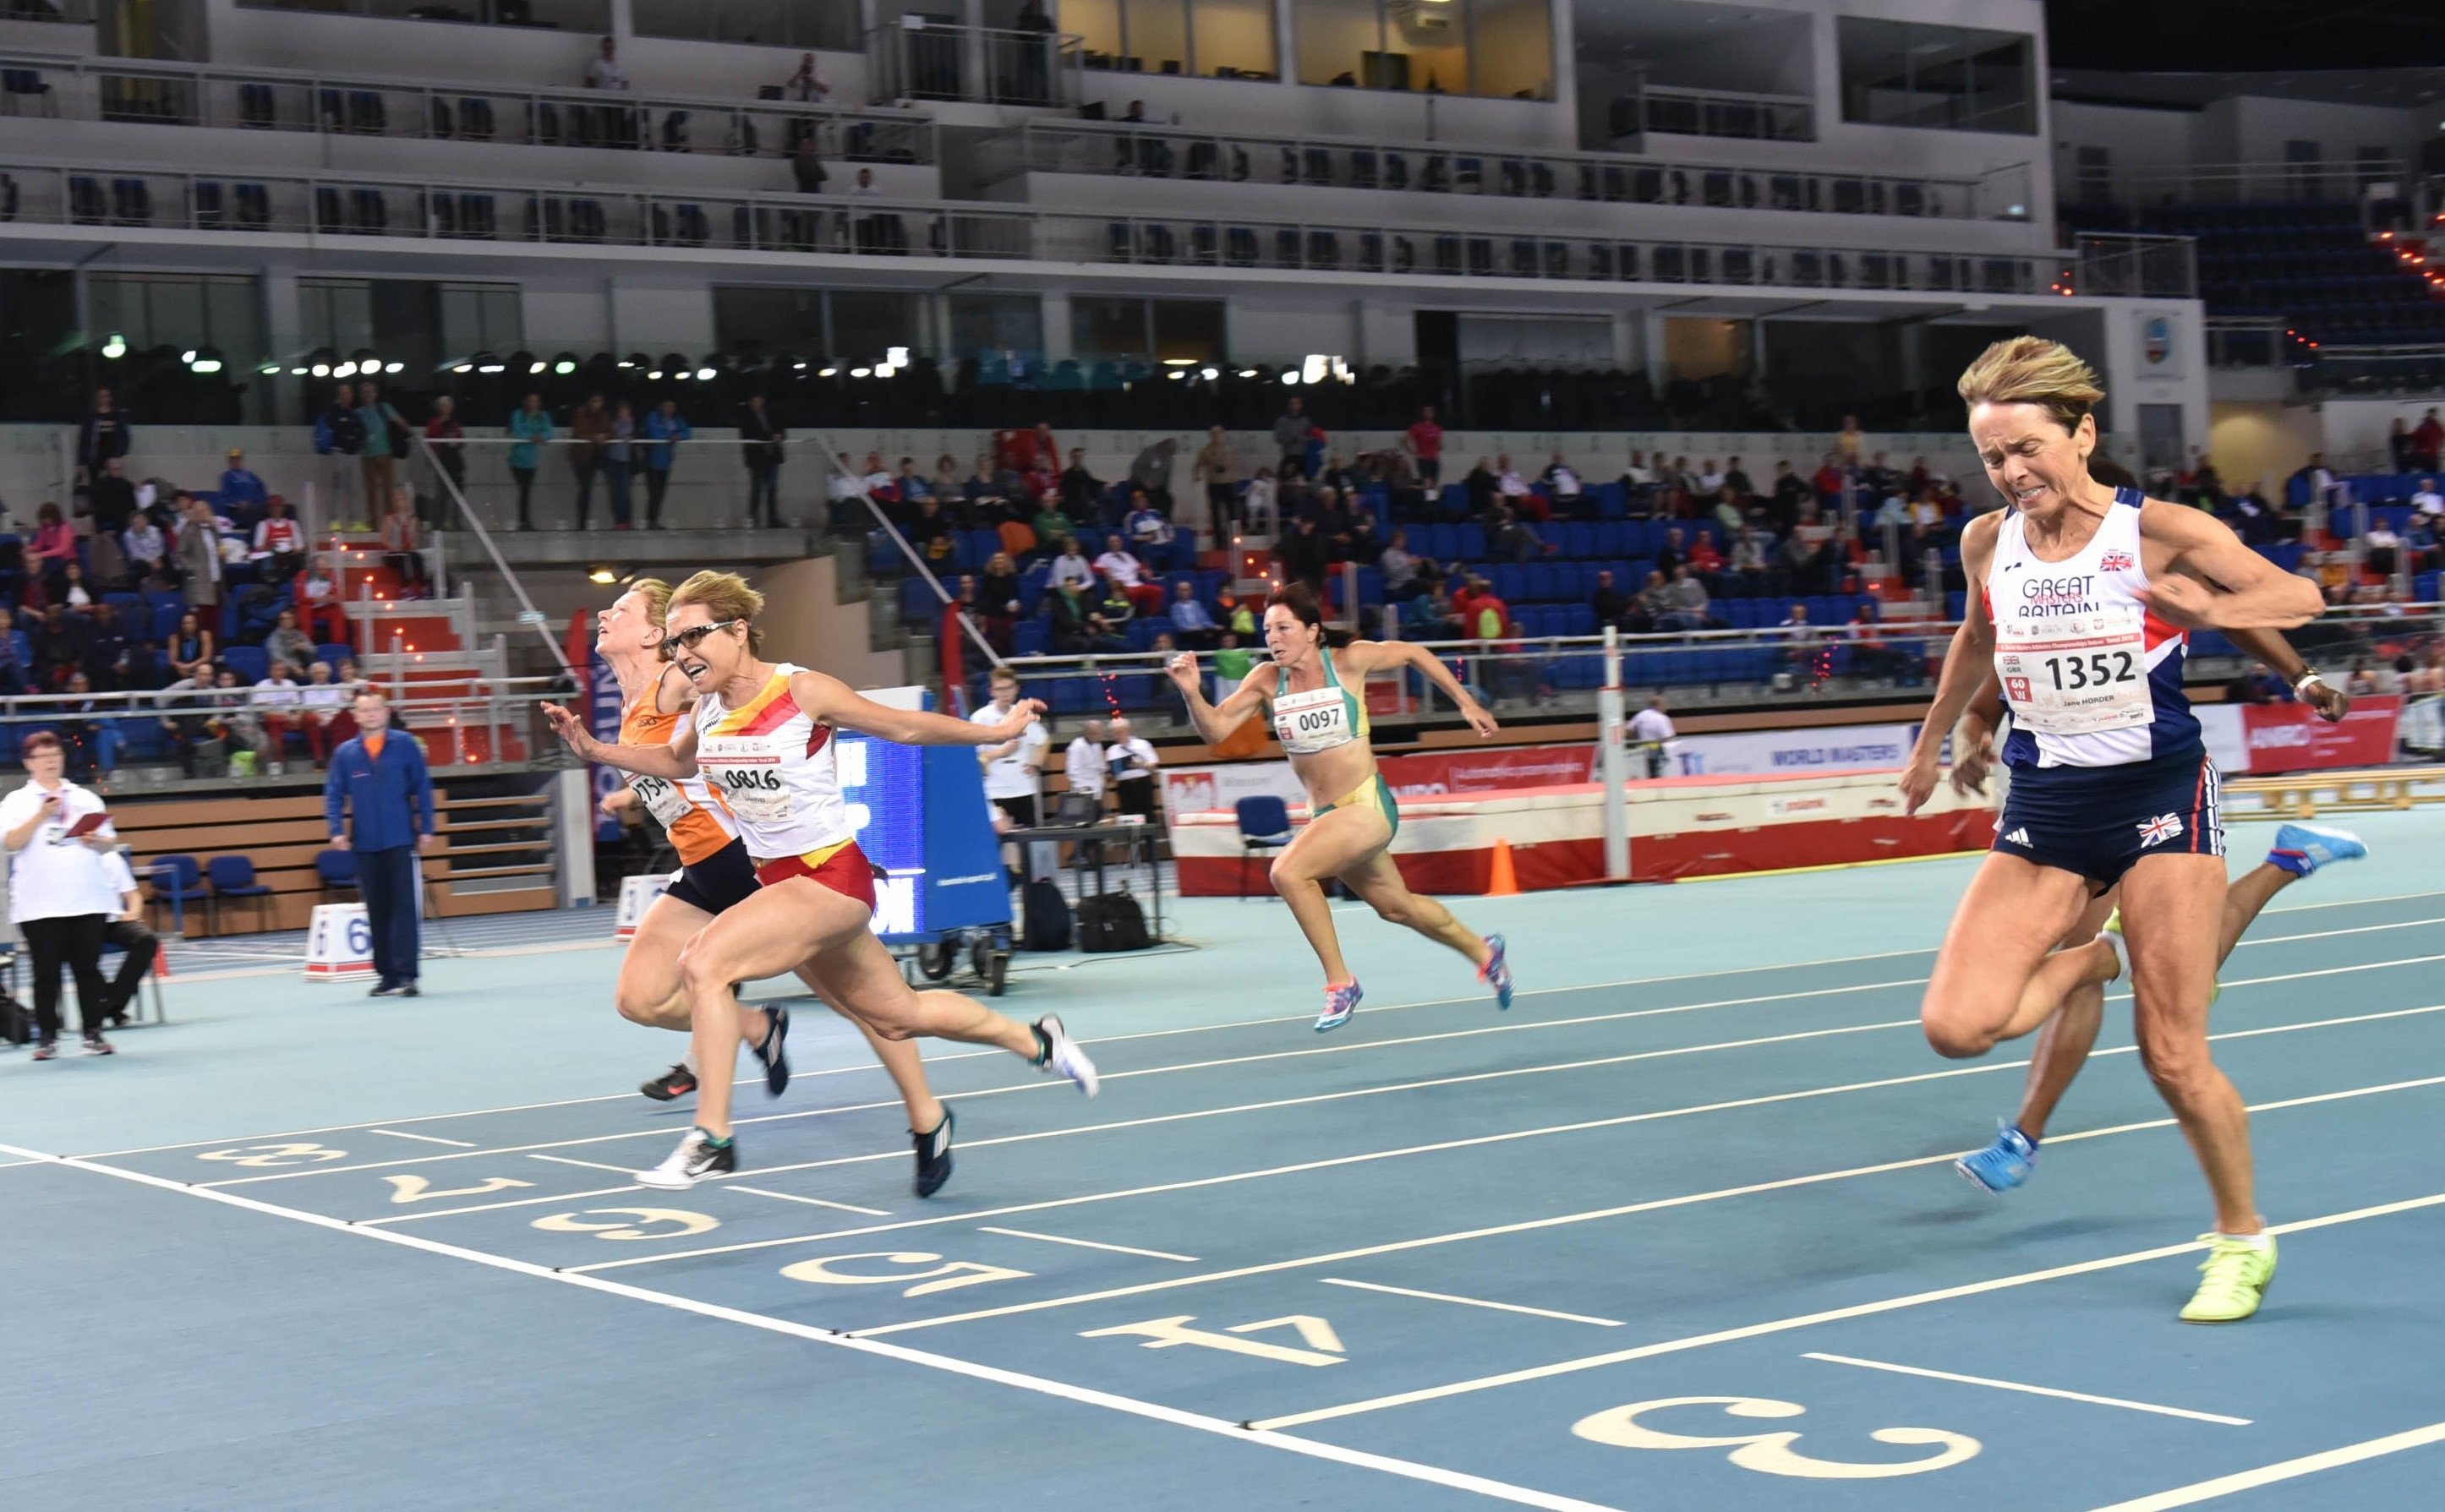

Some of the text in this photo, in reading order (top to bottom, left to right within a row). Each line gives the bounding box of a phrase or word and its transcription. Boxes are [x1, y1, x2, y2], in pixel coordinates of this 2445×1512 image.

[2023, 576, 2095, 599] GREAT
[2030, 592, 2083, 605] MASTERS
[2045, 651, 2136, 690] 1352
[2011, 679, 2025, 689] 60
[2014, 690, 2027, 700] W
[2082, 695, 2114, 705] HORDER
[1299, 708, 1339, 732] 0097
[1772, 749, 1824, 767] WORLD
[725, 768, 781, 791] 0816
[347, 918, 373, 955] 6
[196, 1143, 348, 1166] 8
[379, 1174, 539, 1204] 7
[529, 1207, 722, 1240] 6
[778, 1251, 1037, 1298] 5
[1075, 1314, 1349, 1367] 4
[1570, 1395, 1983, 1478] 3
